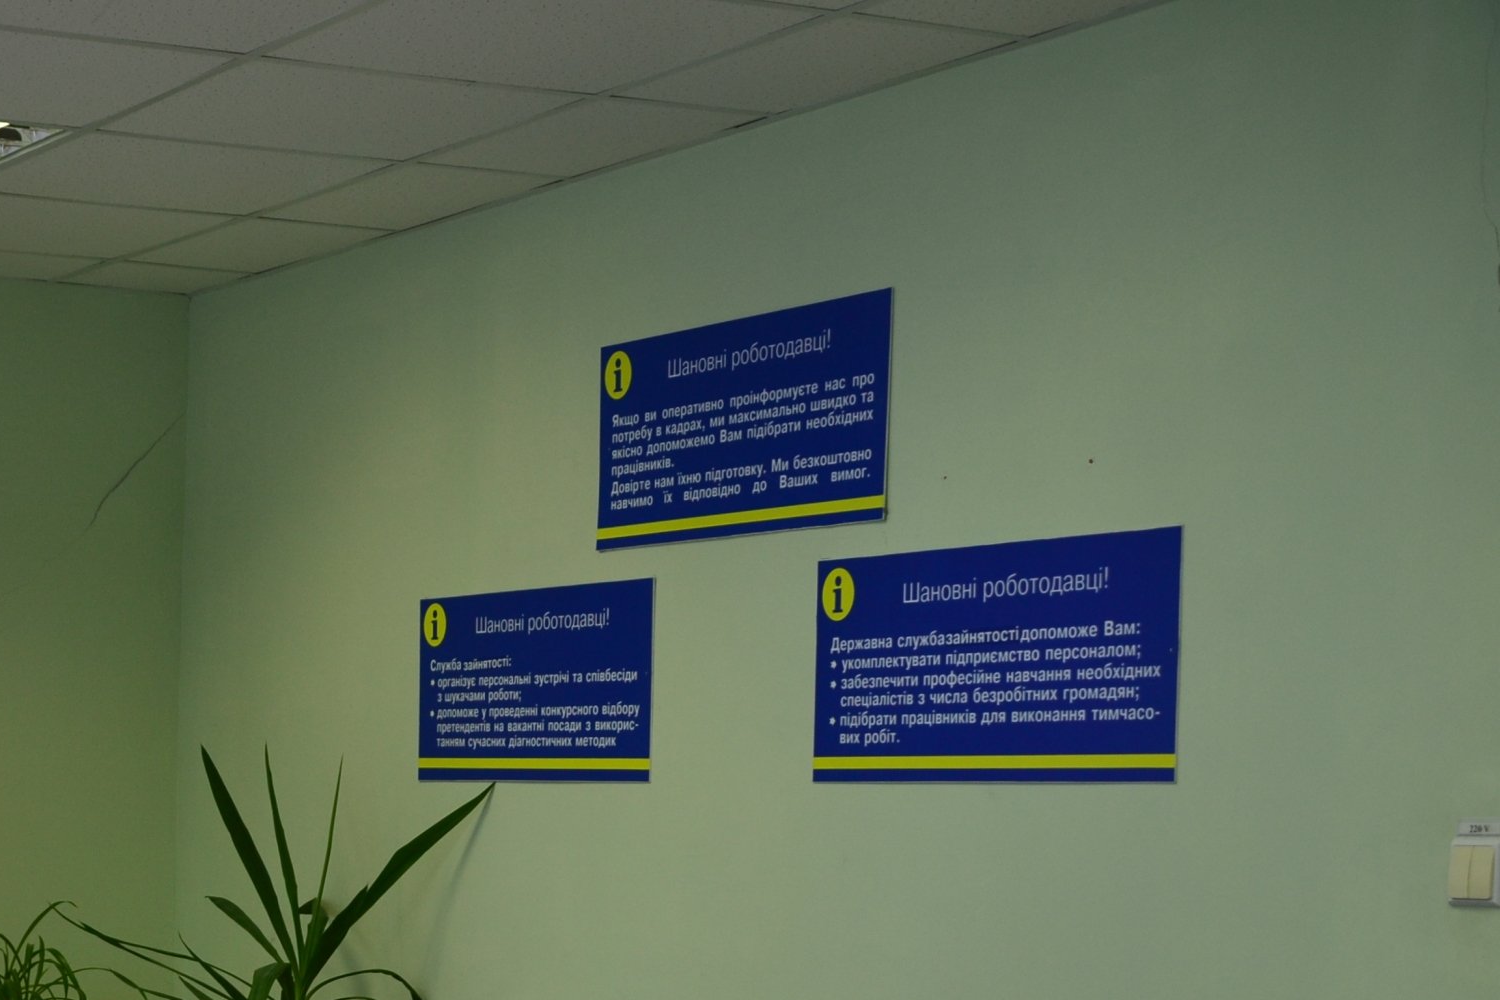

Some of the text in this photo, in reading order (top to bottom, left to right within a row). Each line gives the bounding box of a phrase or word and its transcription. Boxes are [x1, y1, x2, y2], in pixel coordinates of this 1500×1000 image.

[667, 327, 831, 379] Шановні роботодавці!
[612, 372, 875, 428] Якщо ви оперативно проінформуєте нас про
[611, 390, 874, 444] потребу в кадрах, ми максимально швидко та
[611, 409, 874, 460] якісно допоможемо Вам підібрати необхідних
[610, 448, 873, 497] Довірте нам їхню підготовку. Ми безкоштовно
[611, 455, 675, 478] працівників.
[610, 467, 871, 511] навчимо їх відповідно до Ваших вимог.
[902, 566, 1109, 604] Шановні роботодавці!
[475, 614, 525, 635] Шановні
[830, 636, 893, 654] Державна
[1103, 619, 1141, 637] Вам:
[429, 657, 462, 674] Служба
[841, 644, 1141, 674] укомплектувати підприємство персоналом;
[437, 676, 476, 691] організує
[478, 672, 532, 689] персональні
[533, 670, 570, 688] зустрічі
[585, 667, 638, 683] співбесіди
[840, 662, 1161, 690] забезпечити професійне навчання необхідних
[444, 691, 486, 705] шукачами
[839, 685, 1140, 709] спеціалістів з числа безробітних громадян;
[436, 707, 480, 720] допоможе
[488, 703, 539, 720] проведенні
[540, 704, 599, 719] конкурсного
[601, 700, 640, 718] відбору
[839, 707, 1161, 729] підібрати працівників для виконання тимчасо-
[436, 719, 491, 735] претендентів
[507, 719, 545, 733] вакантні
[547, 721, 582, 733] посади
[839, 728, 900, 747] вих робіт.
[436, 734, 617, 750] танням сучасних діагностичних методик
